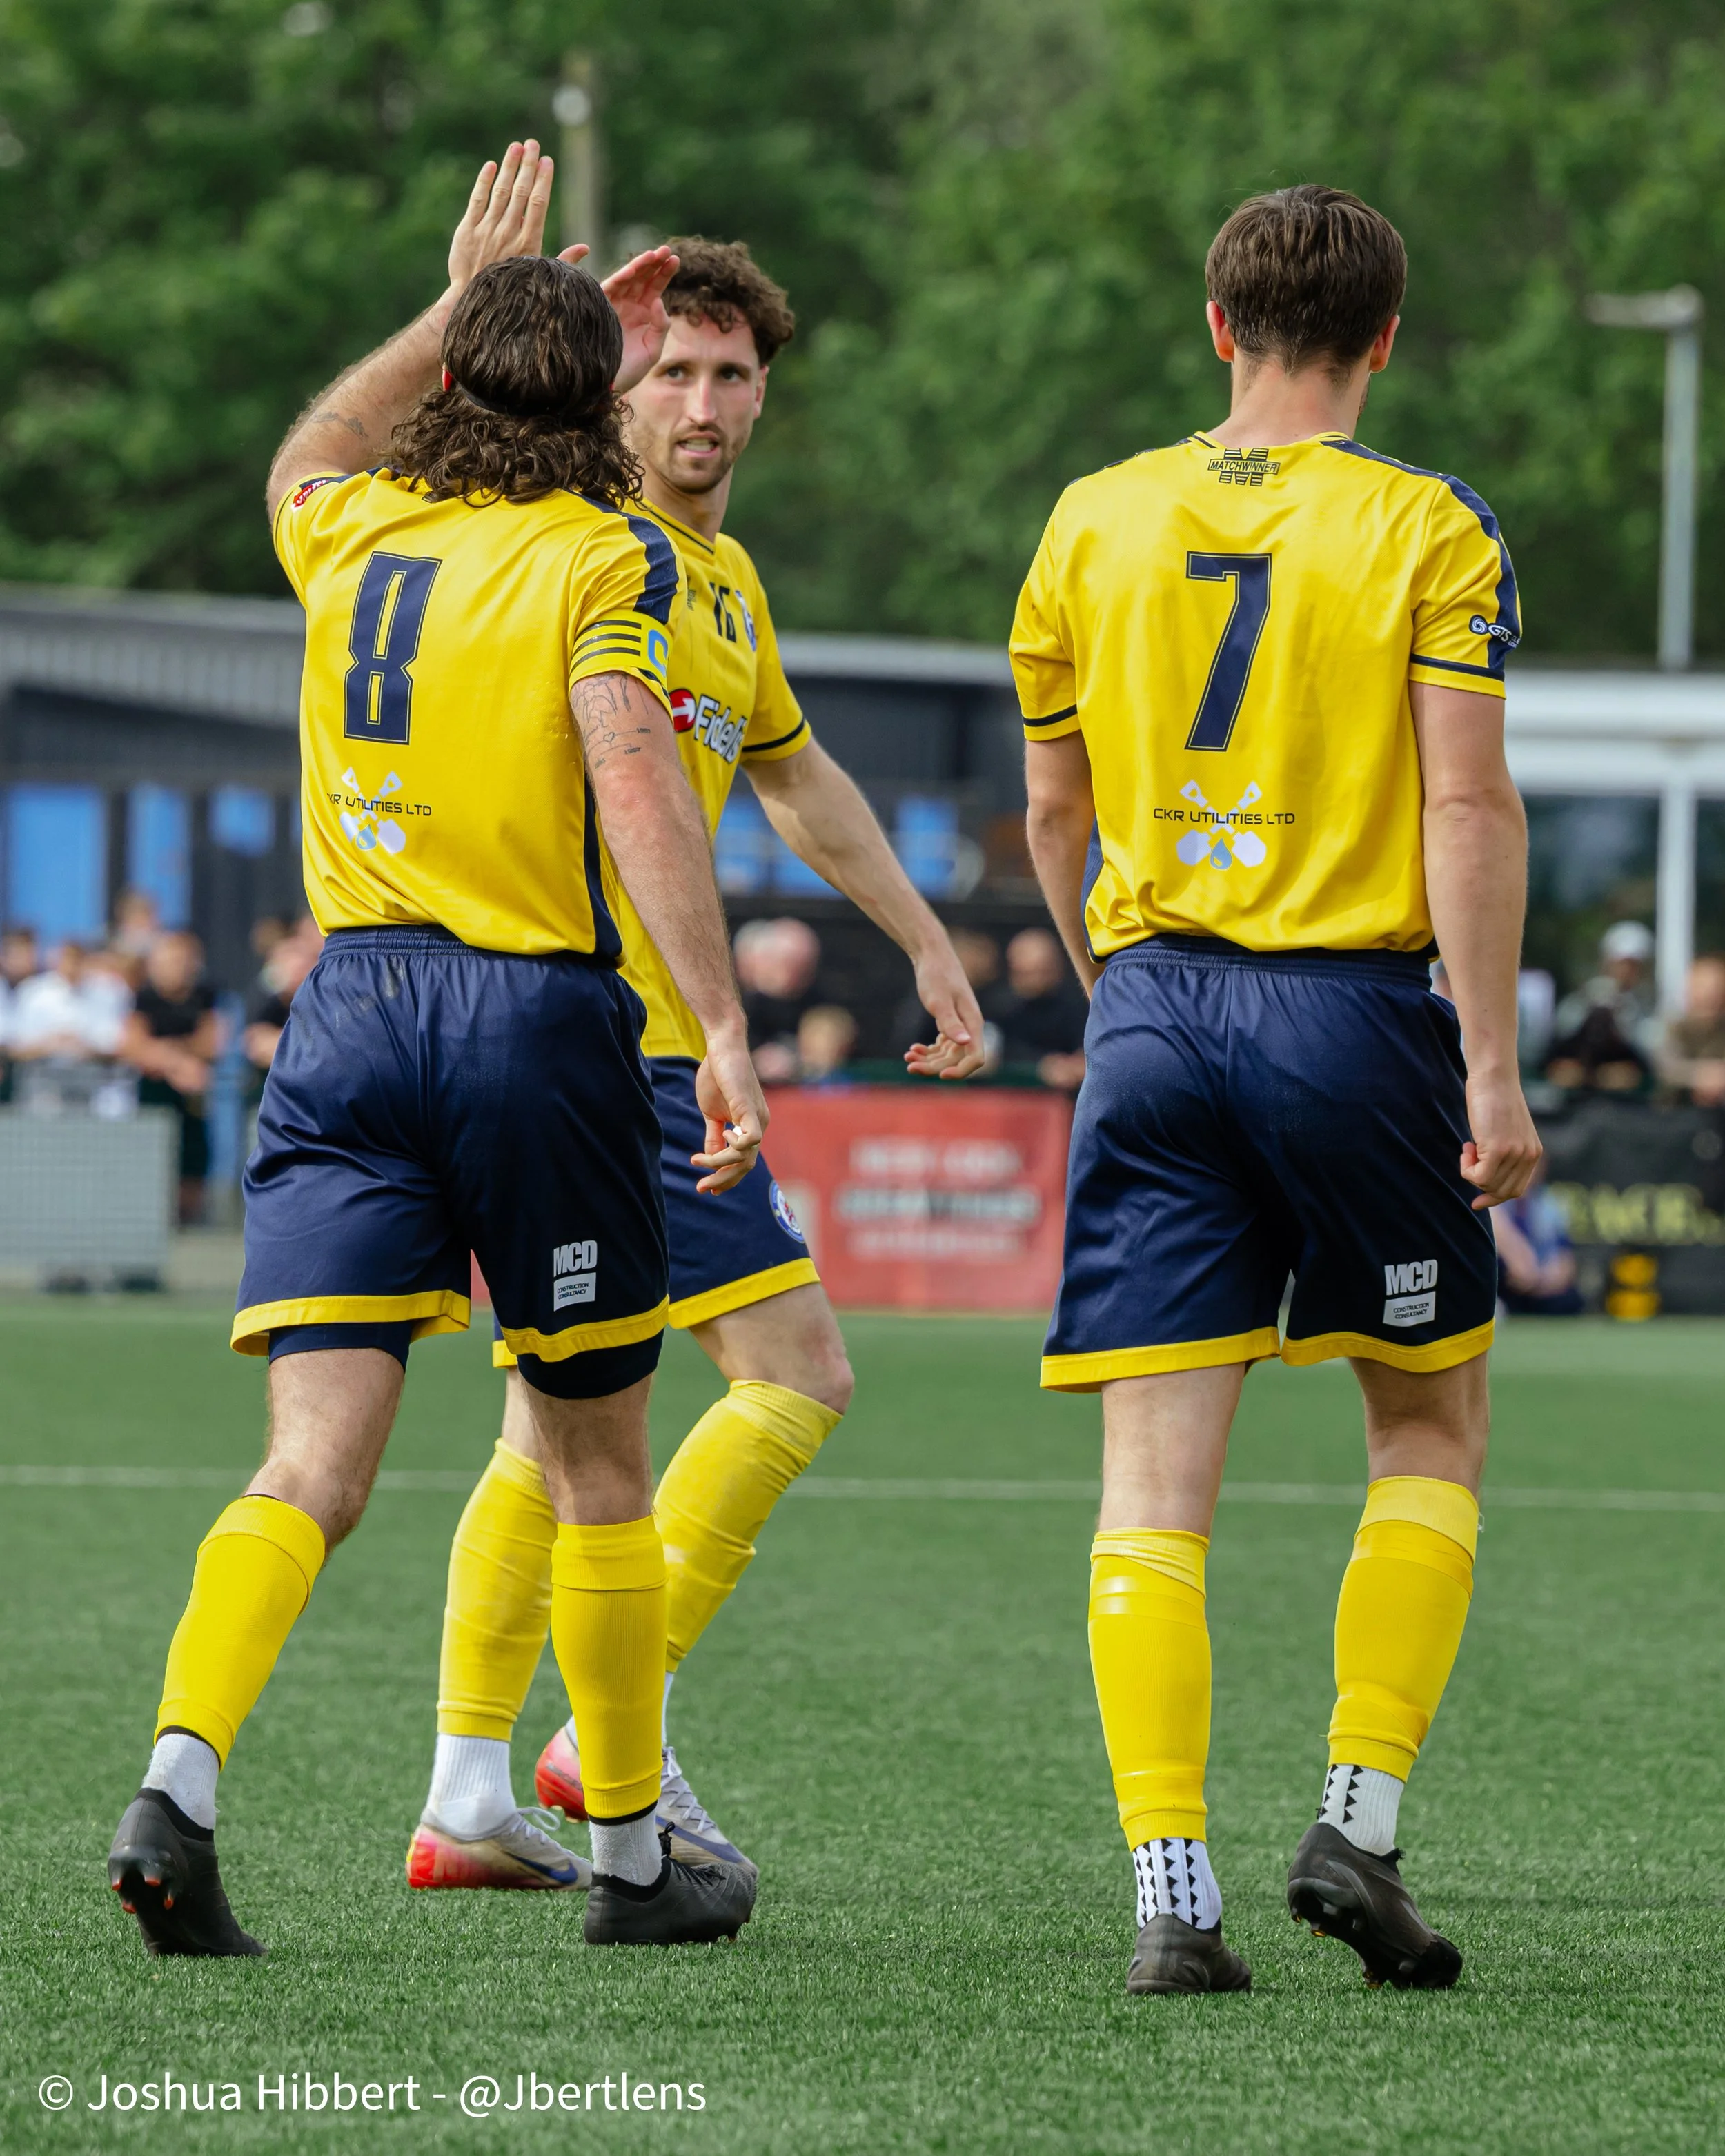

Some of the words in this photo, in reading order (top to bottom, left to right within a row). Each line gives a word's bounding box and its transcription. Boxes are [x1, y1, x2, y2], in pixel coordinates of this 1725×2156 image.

[1210, 460, 1278, 473] MATCHWINNER
[344, 551, 442, 745] 8
[1184, 551, 1272, 752] 7
[1488, 624, 1512, 642] GTS
[647, 629, 669, 678] C
[345, 795, 402, 813] UTILITIES
[406, 804, 432, 816] LTD
[1154, 808, 1184, 821] CKR
[1190, 811, 1263, 824] UTILITIES
[1266, 813, 1295, 824] LTD
[553, 1240, 598, 1278] MCD
[1384, 1259, 1438, 1296] MCD
